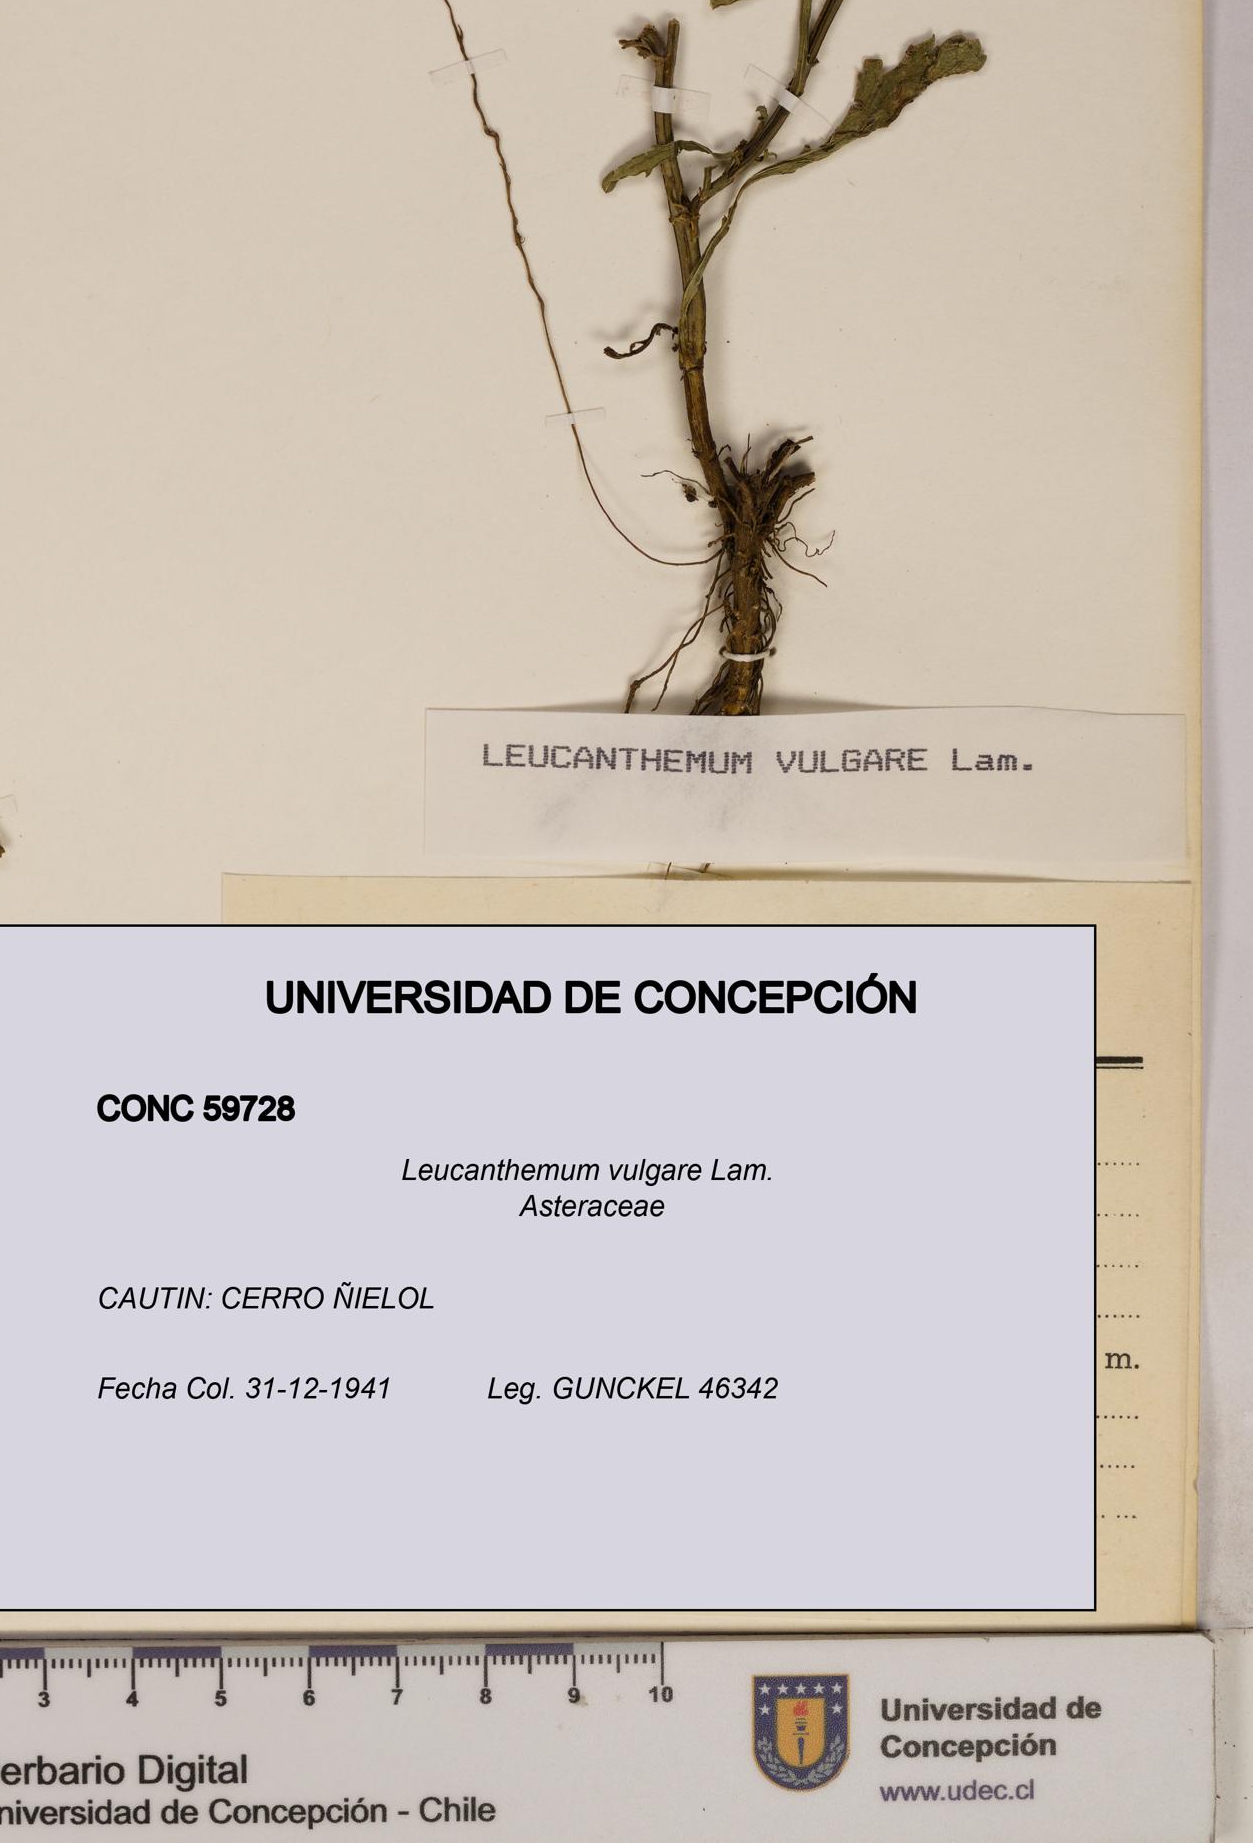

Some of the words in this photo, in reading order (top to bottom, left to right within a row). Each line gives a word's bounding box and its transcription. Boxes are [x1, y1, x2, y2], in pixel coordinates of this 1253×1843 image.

[483, 744, 752, 774] LEUCANTHEMUM
[776, 748, 927, 773] VULGARE
[952, 748, 1032, 771] Lam.
[1105, 1353, 1139, 1369] m.
[37, 1690, 51, 1708] 3
[125, 1690, 140, 1708] 4
[214, 1690, 228, 1708] 5
[302, 1689, 316, 1707] 6
[390, 1688, 404, 1706] 7
[479, 1687, 493, 1705] 8
[567, 1687, 582, 1705] 9
[648, 1685, 674, 1703] 10
[882, 1696, 1056, 1721] Universidad
[1066, 1696, 1101, 1719] de
[880, 1733, 1056, 1762] Concepción
[139, 1754, 247, 1792] Digital
[880, 1779, 1034, 1801] www.udec.cl
[161, 1799, 198, 1824] de
[209, 1798, 387, 1829] Concepción
[420, 1797, 496, 1822] Chile
